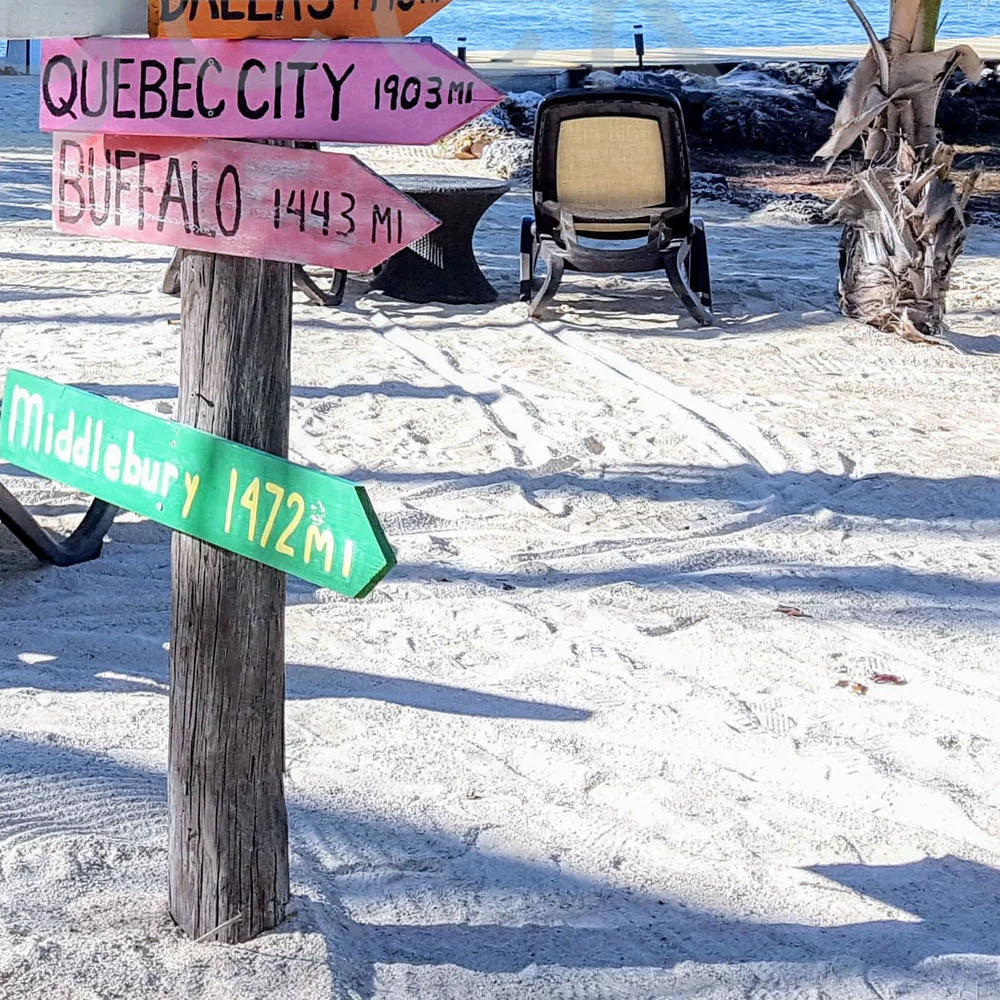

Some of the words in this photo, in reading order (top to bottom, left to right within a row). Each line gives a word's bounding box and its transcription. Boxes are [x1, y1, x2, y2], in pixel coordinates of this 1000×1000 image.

[41, 53, 227, 122] QUEBEC
[236, 57, 356, 122] CITY
[372, 74, 443, 112] 1903
[446, 80, 475, 106] MI
[58, 138, 242, 239] BUFFALO
[272, 188, 357, 238] 1443
[370, 204, 404, 245] MI
[6, 382, 202, 518] Middlebury
[223, 467, 308, 556] 1472
[302, 522, 355, 580] MI
